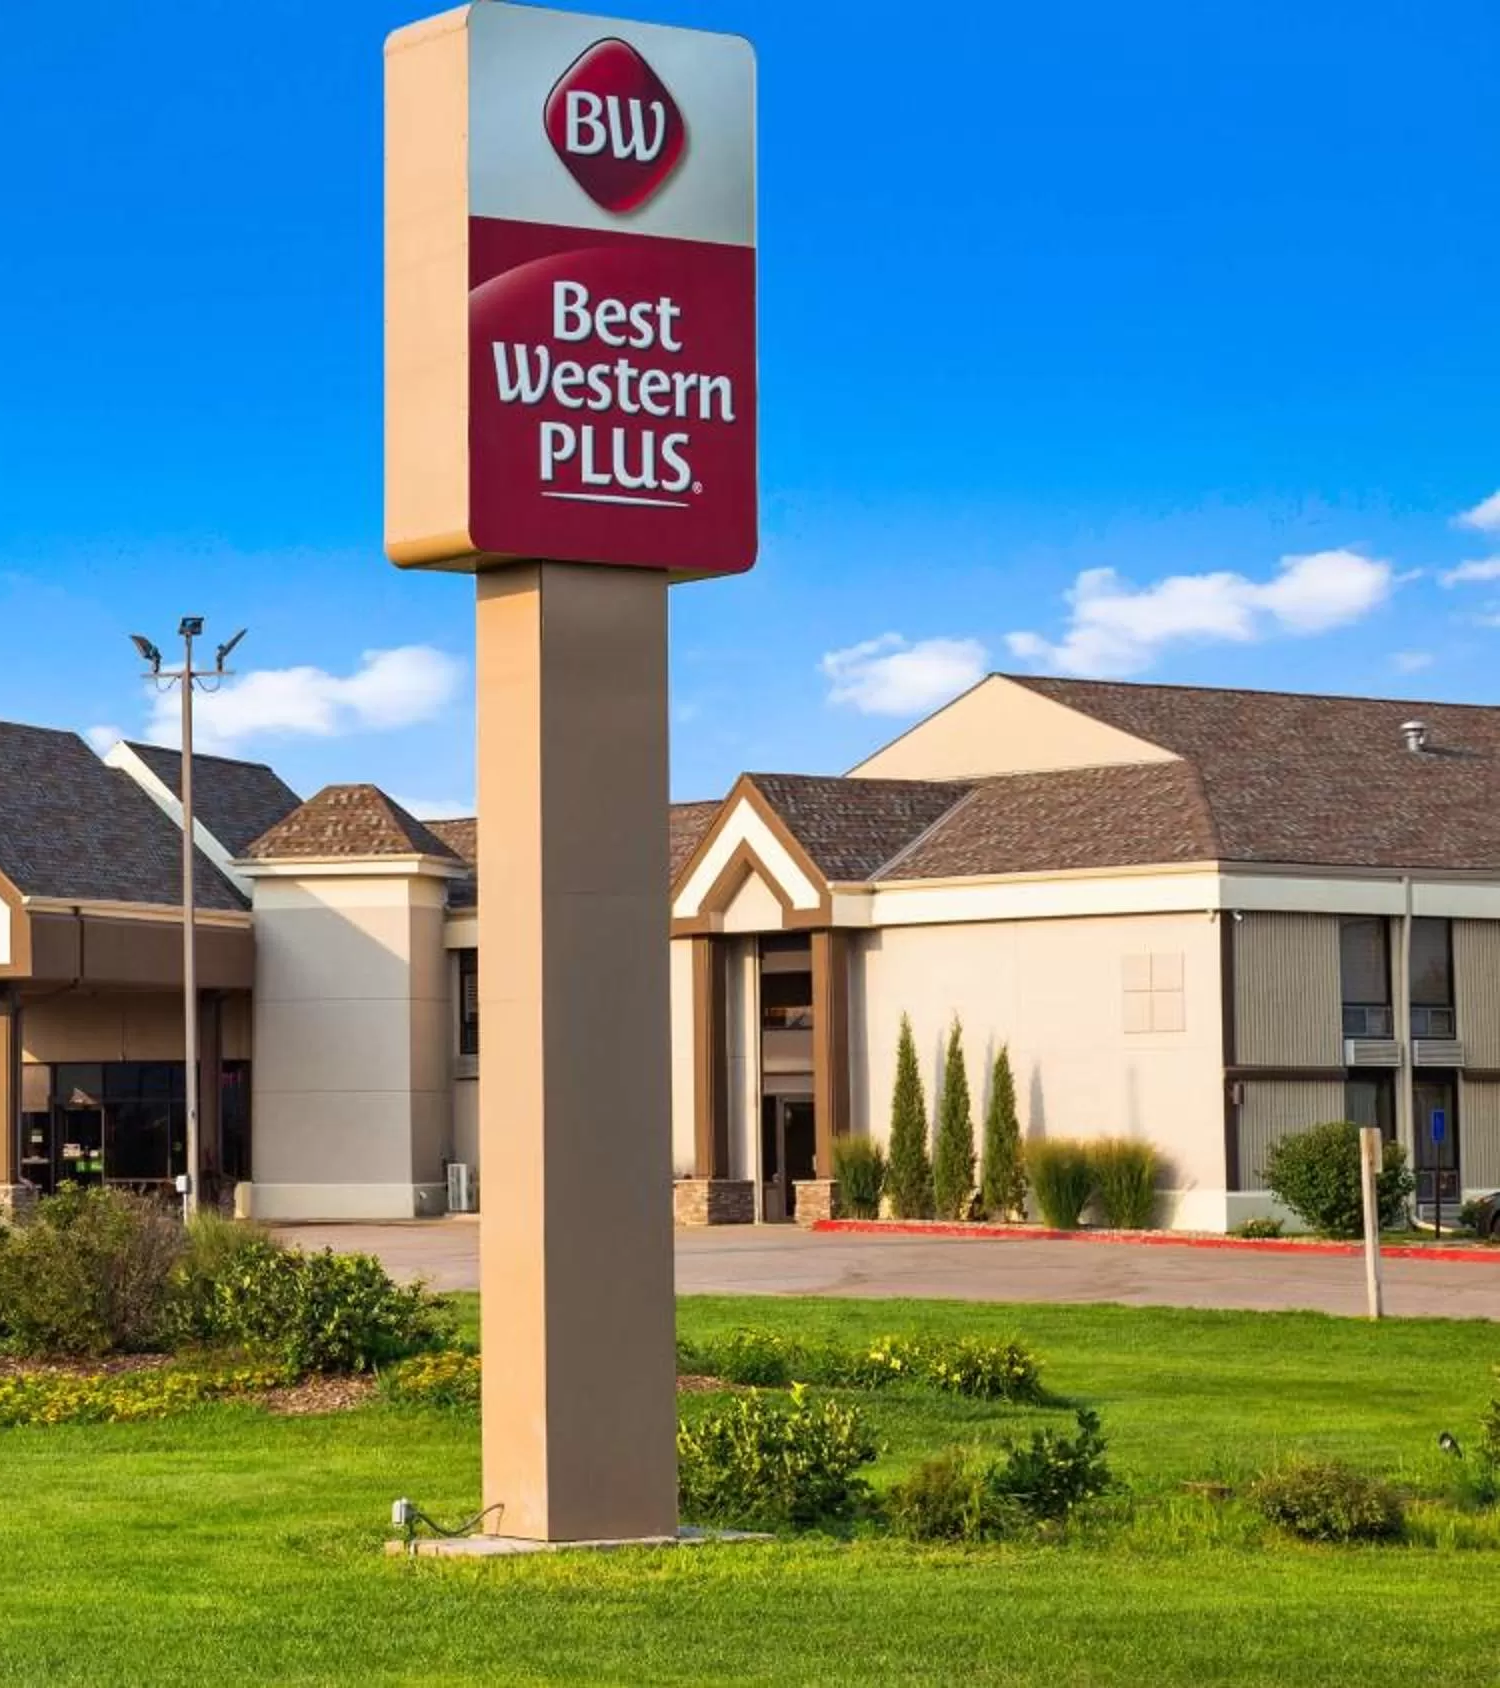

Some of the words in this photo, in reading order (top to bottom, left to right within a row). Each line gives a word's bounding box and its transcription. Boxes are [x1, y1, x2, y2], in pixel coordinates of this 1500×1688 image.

[565, 89, 665, 162] BW
[553, 280, 682, 352] Best
[492, 341, 735, 421] Western
